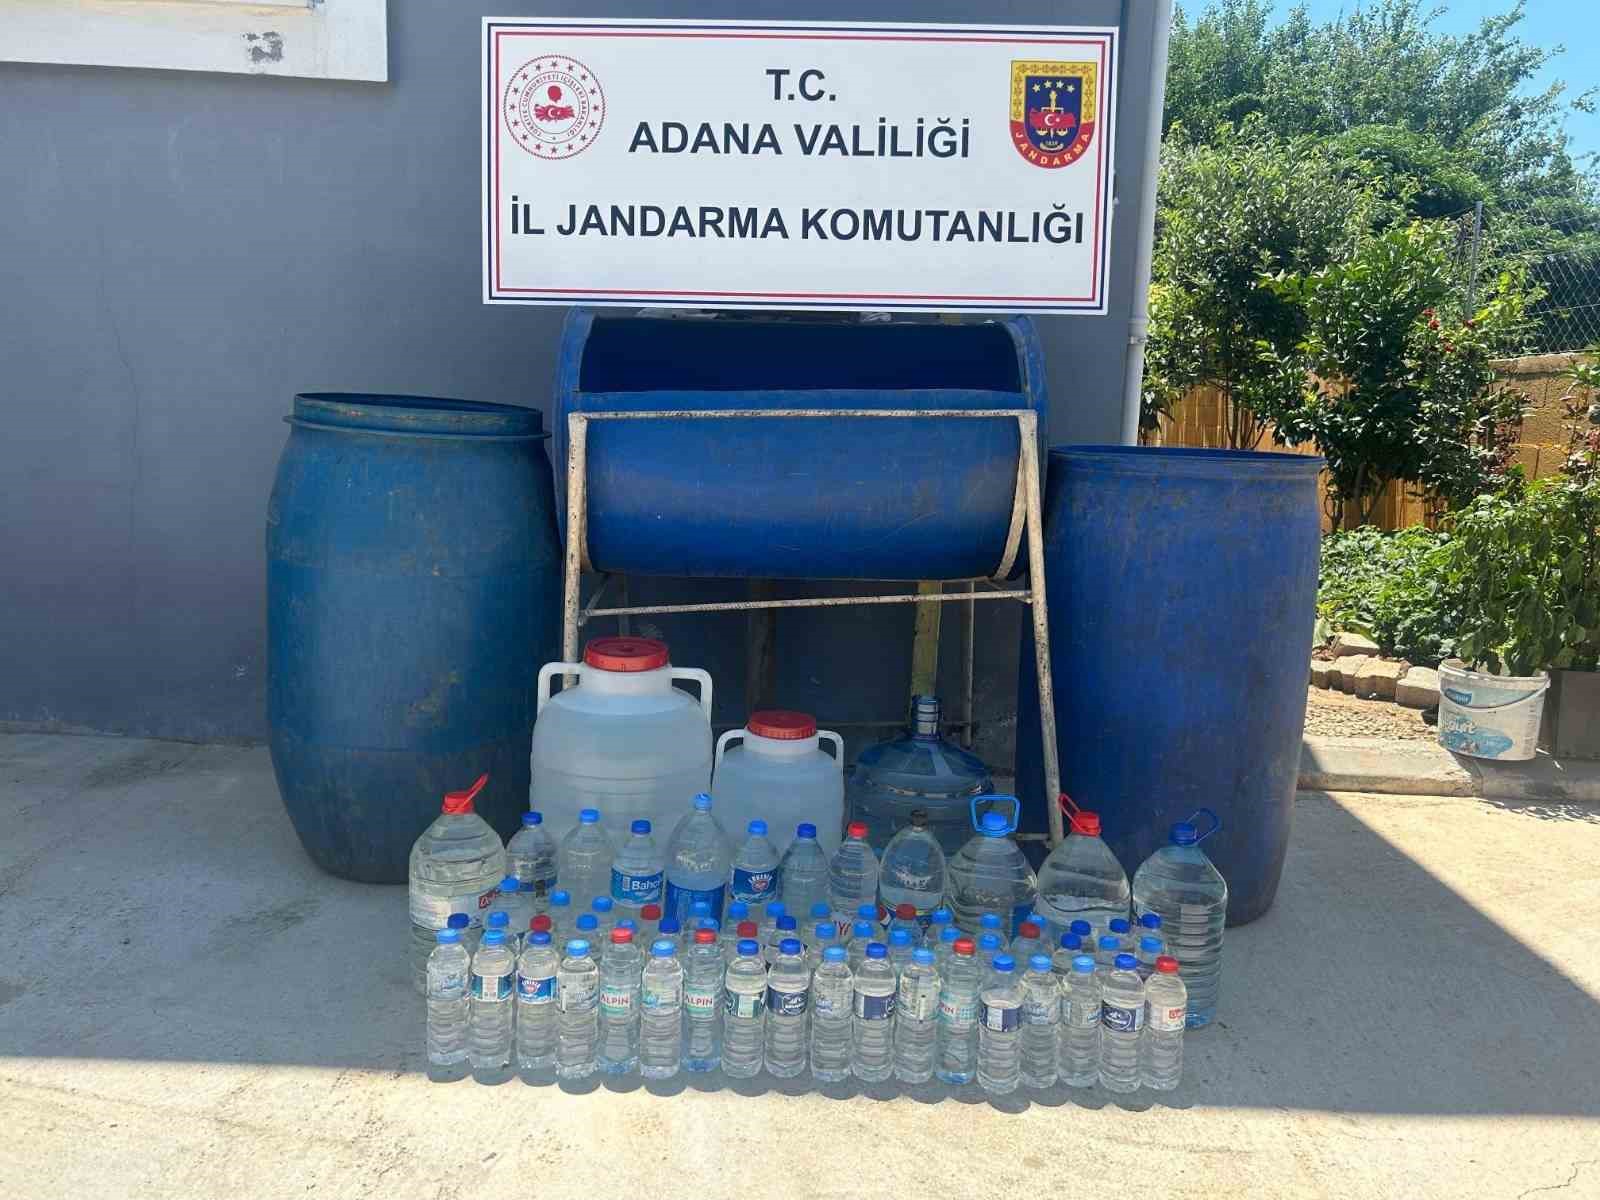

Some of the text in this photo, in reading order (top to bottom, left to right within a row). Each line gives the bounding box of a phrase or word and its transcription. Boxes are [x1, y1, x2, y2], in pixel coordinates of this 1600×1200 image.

[765, 68, 836, 102] T.C.
[628, 116, 970, 158] ADANA VALİLİĞİ
[1015, 132, 1090, 167] JANDARMA
[511, 195, 1084, 244] İL JANDARMA KOMUTANLIĞI
[600, 994, 630, 1007] ALPIN
